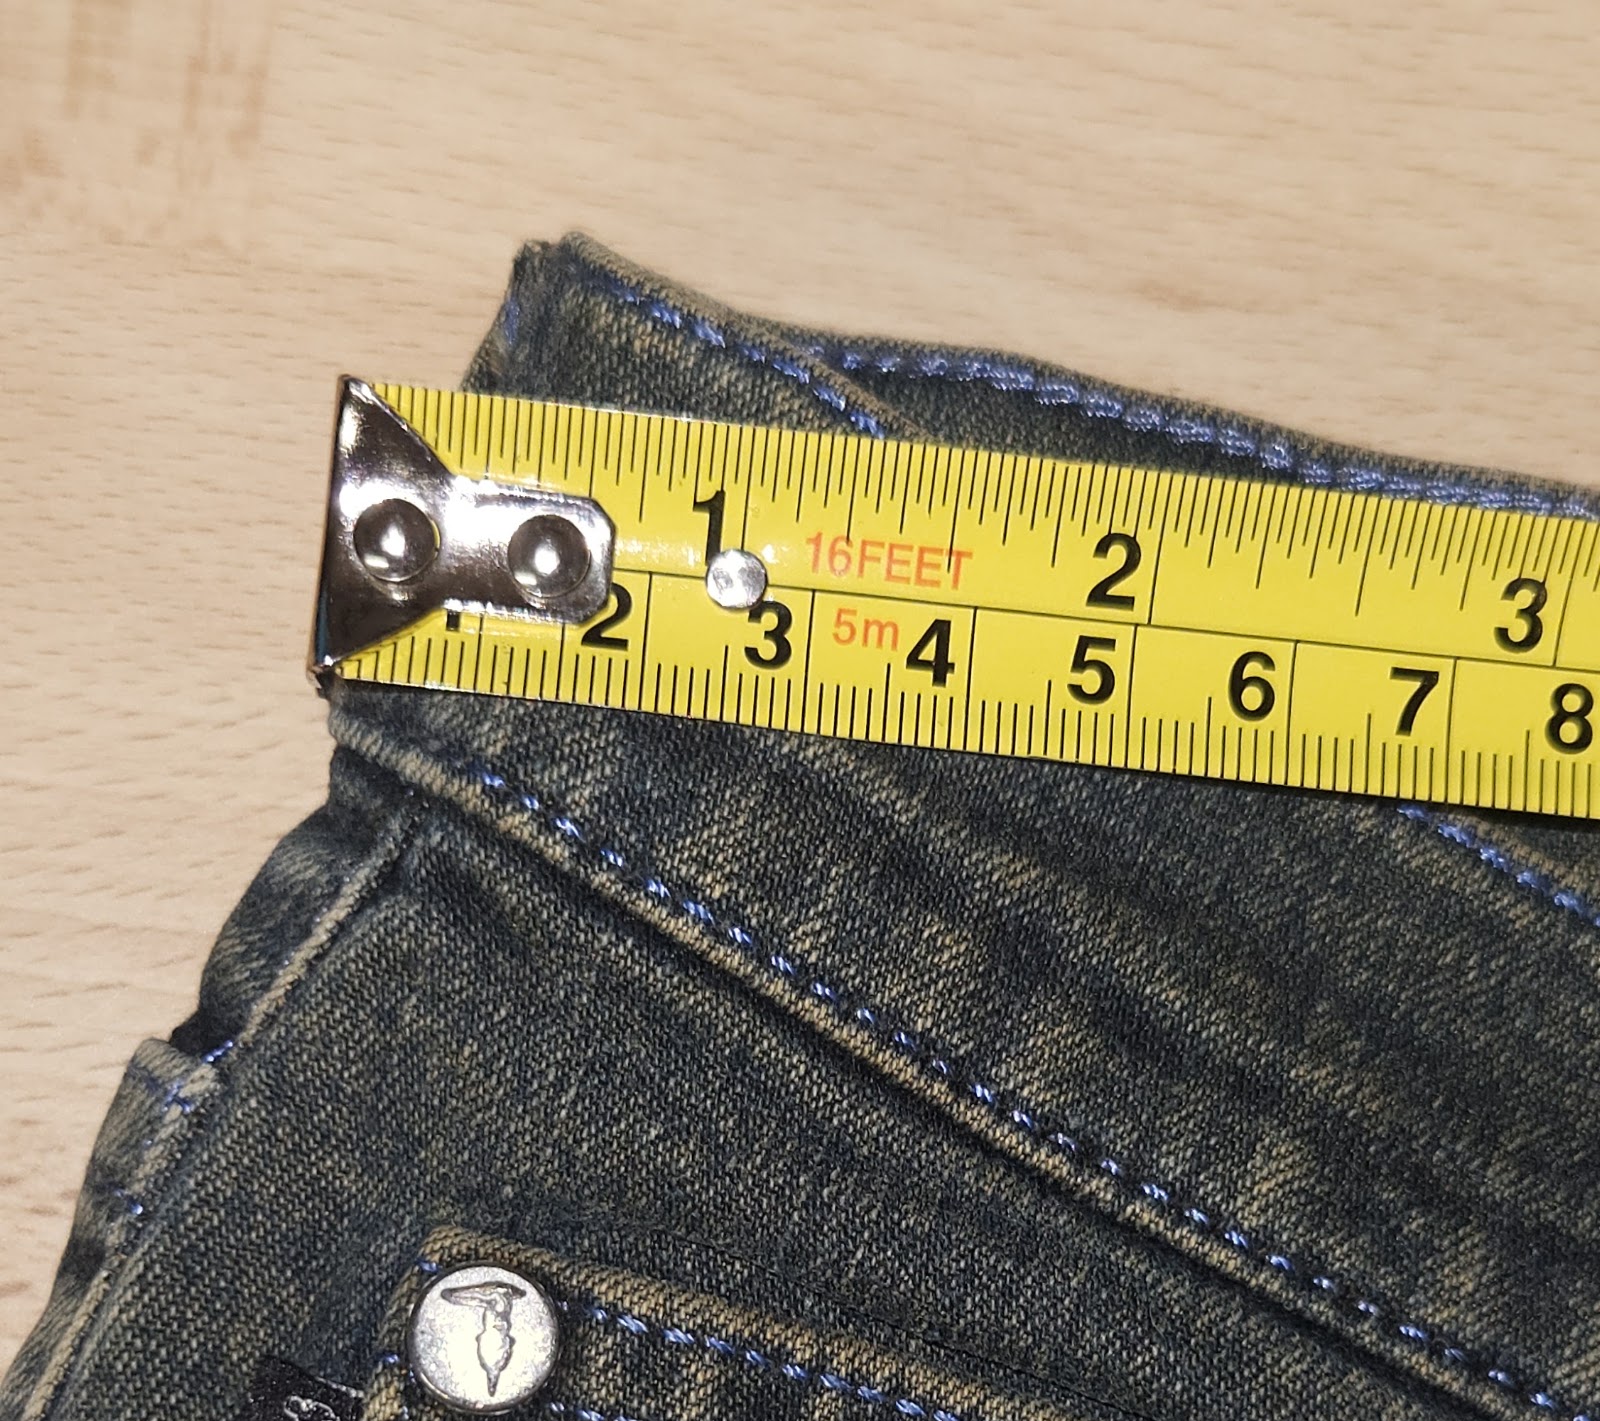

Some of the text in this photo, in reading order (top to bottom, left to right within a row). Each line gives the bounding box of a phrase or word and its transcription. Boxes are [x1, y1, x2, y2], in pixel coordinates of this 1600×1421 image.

[693, 489, 725, 567] 1
[806, 531, 973, 590] 16FEET
[1086, 532, 1142, 611] 2
[581, 582, 634, 651] 2
[744, 600, 793, 670] 3
[832, 608, 900, 651] 5m
[1493, 577, 1548, 653] 3
[906, 618, 956, 687] 4
[1066, 634, 1117, 705] 5
[1227, 651, 1276, 721] 6
[1389, 666, 1440, 737] 7
[1544, 682, 1595, 755] 8
